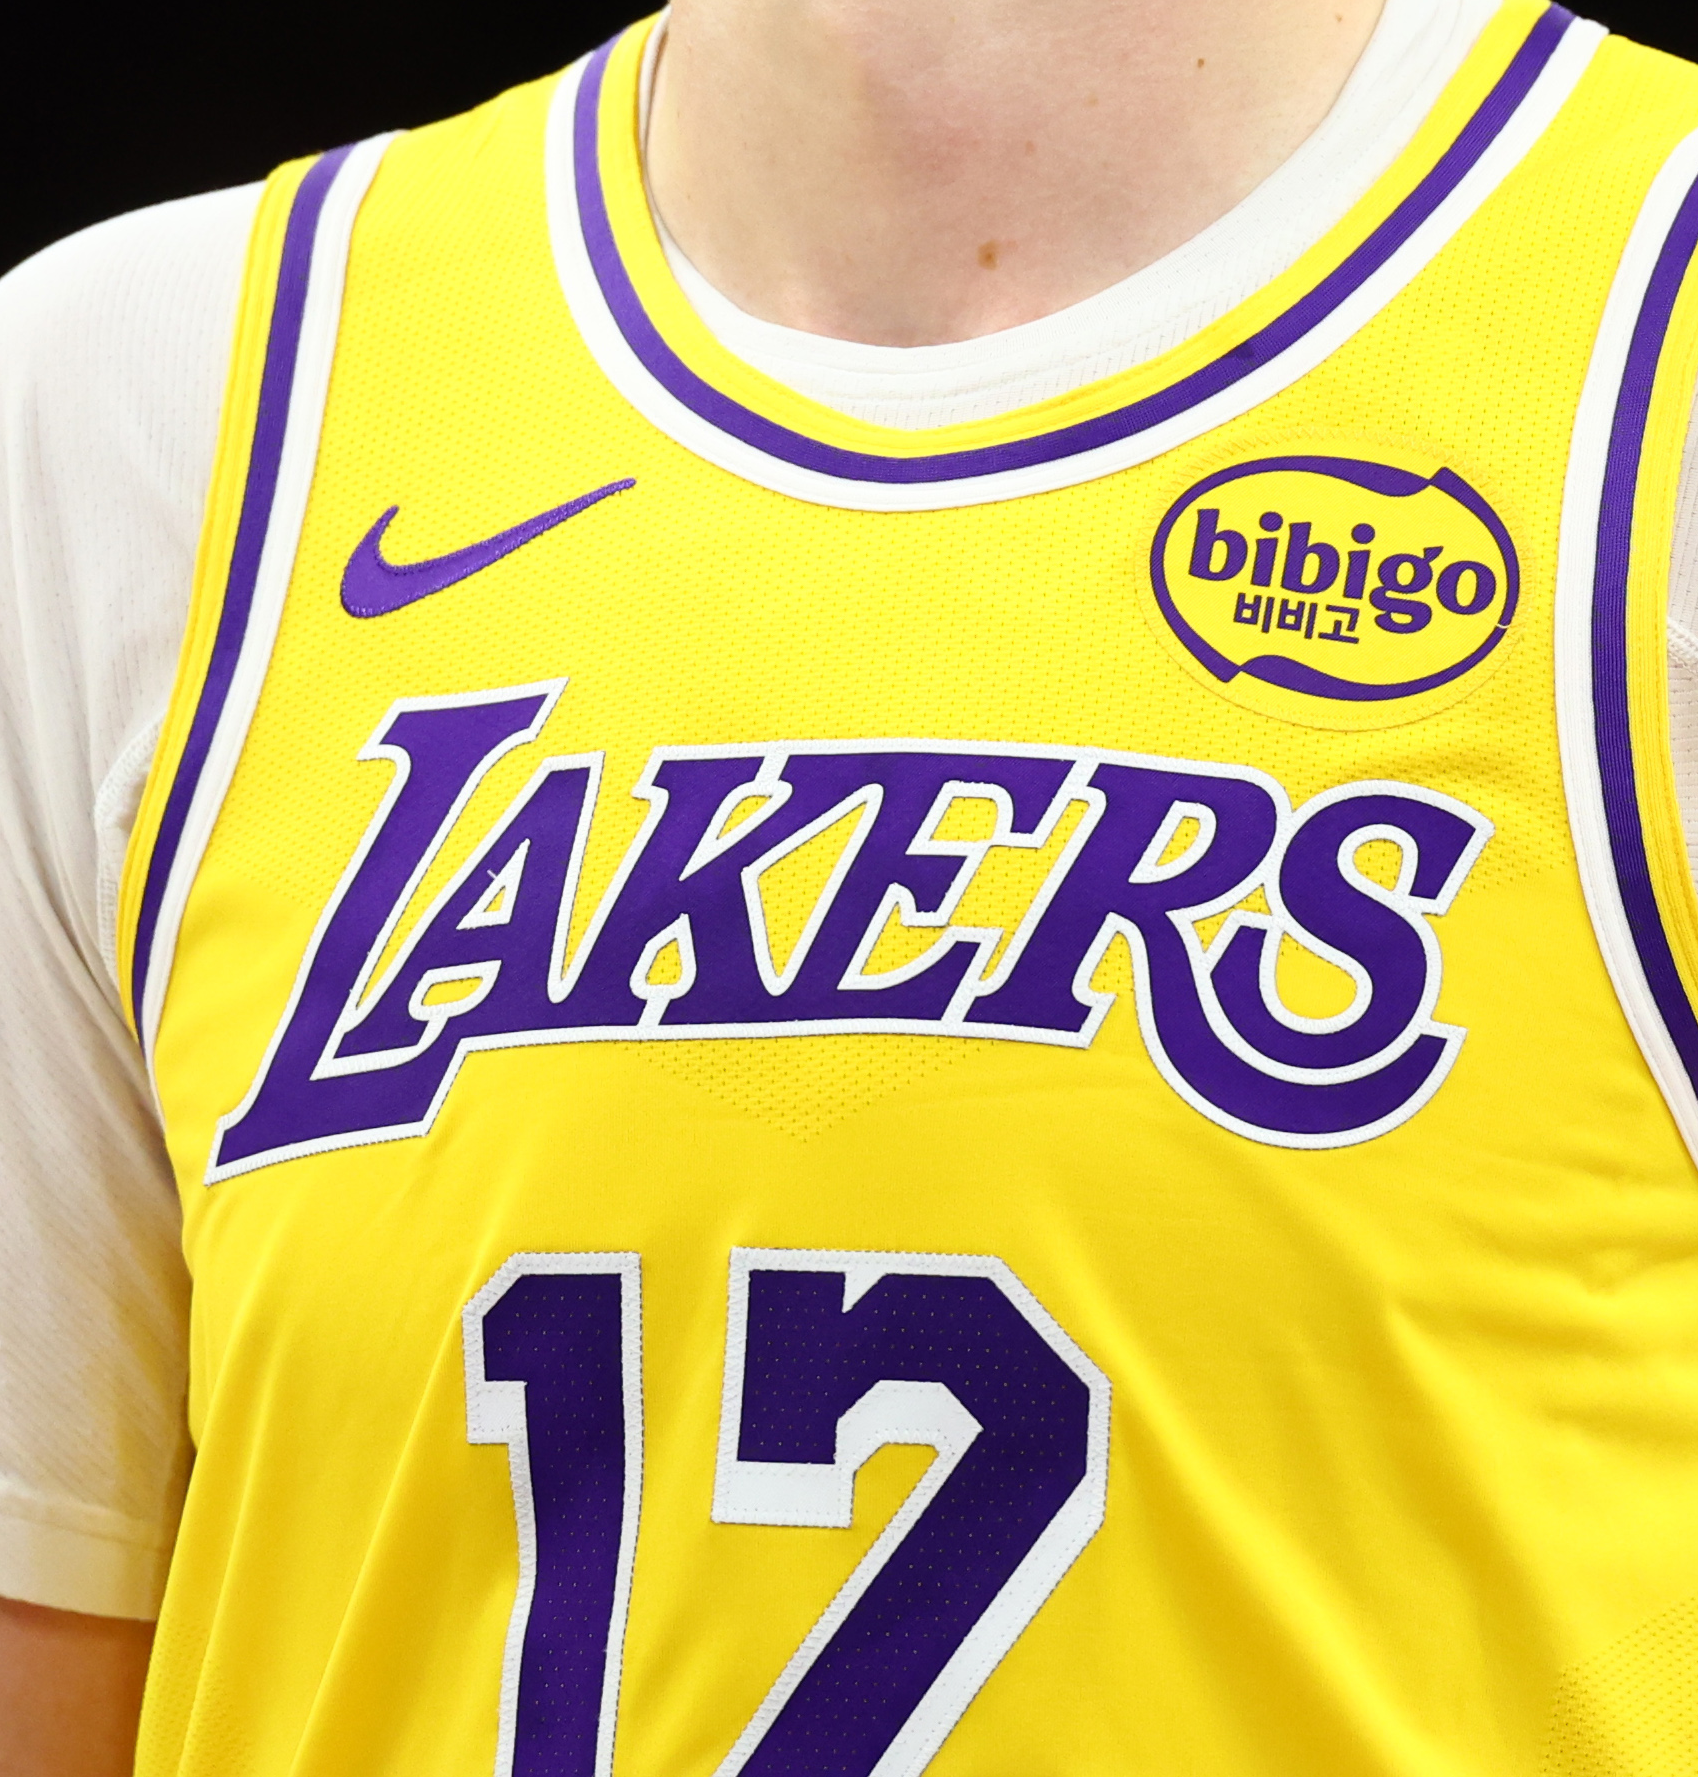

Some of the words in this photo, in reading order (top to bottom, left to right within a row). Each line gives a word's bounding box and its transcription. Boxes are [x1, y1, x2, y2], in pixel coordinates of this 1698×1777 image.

[1189, 508, 1497, 634] bibigo
[1233, 592, 1360, 644] 비비고
[206, 679, 1495, 1183] LAKERS
[461, 1246, 1112, 1777] 12
